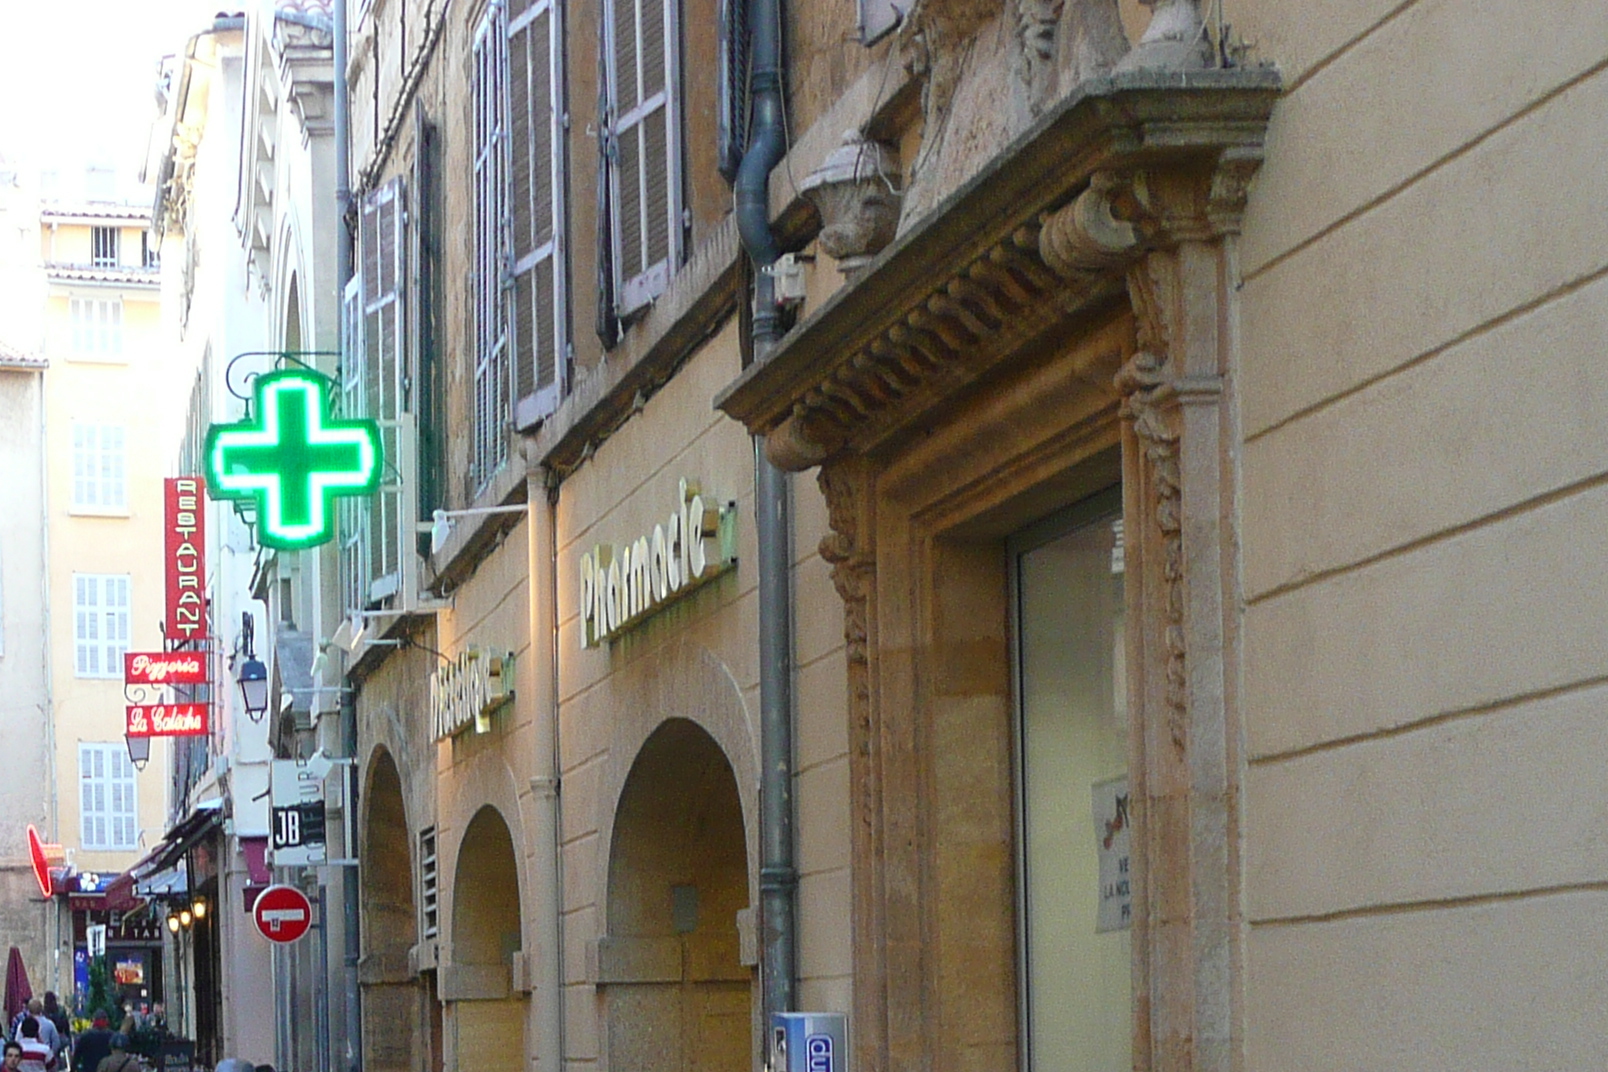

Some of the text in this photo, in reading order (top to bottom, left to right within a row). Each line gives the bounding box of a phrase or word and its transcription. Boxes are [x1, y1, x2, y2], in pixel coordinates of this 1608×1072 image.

[175, 480, 201, 638] RESTAURANT
[579, 476, 706, 650] Pharmacie
[131, 655, 199, 681] Pizzeria
[129, 707, 148, 732] La
[275, 810, 300, 845] JB
